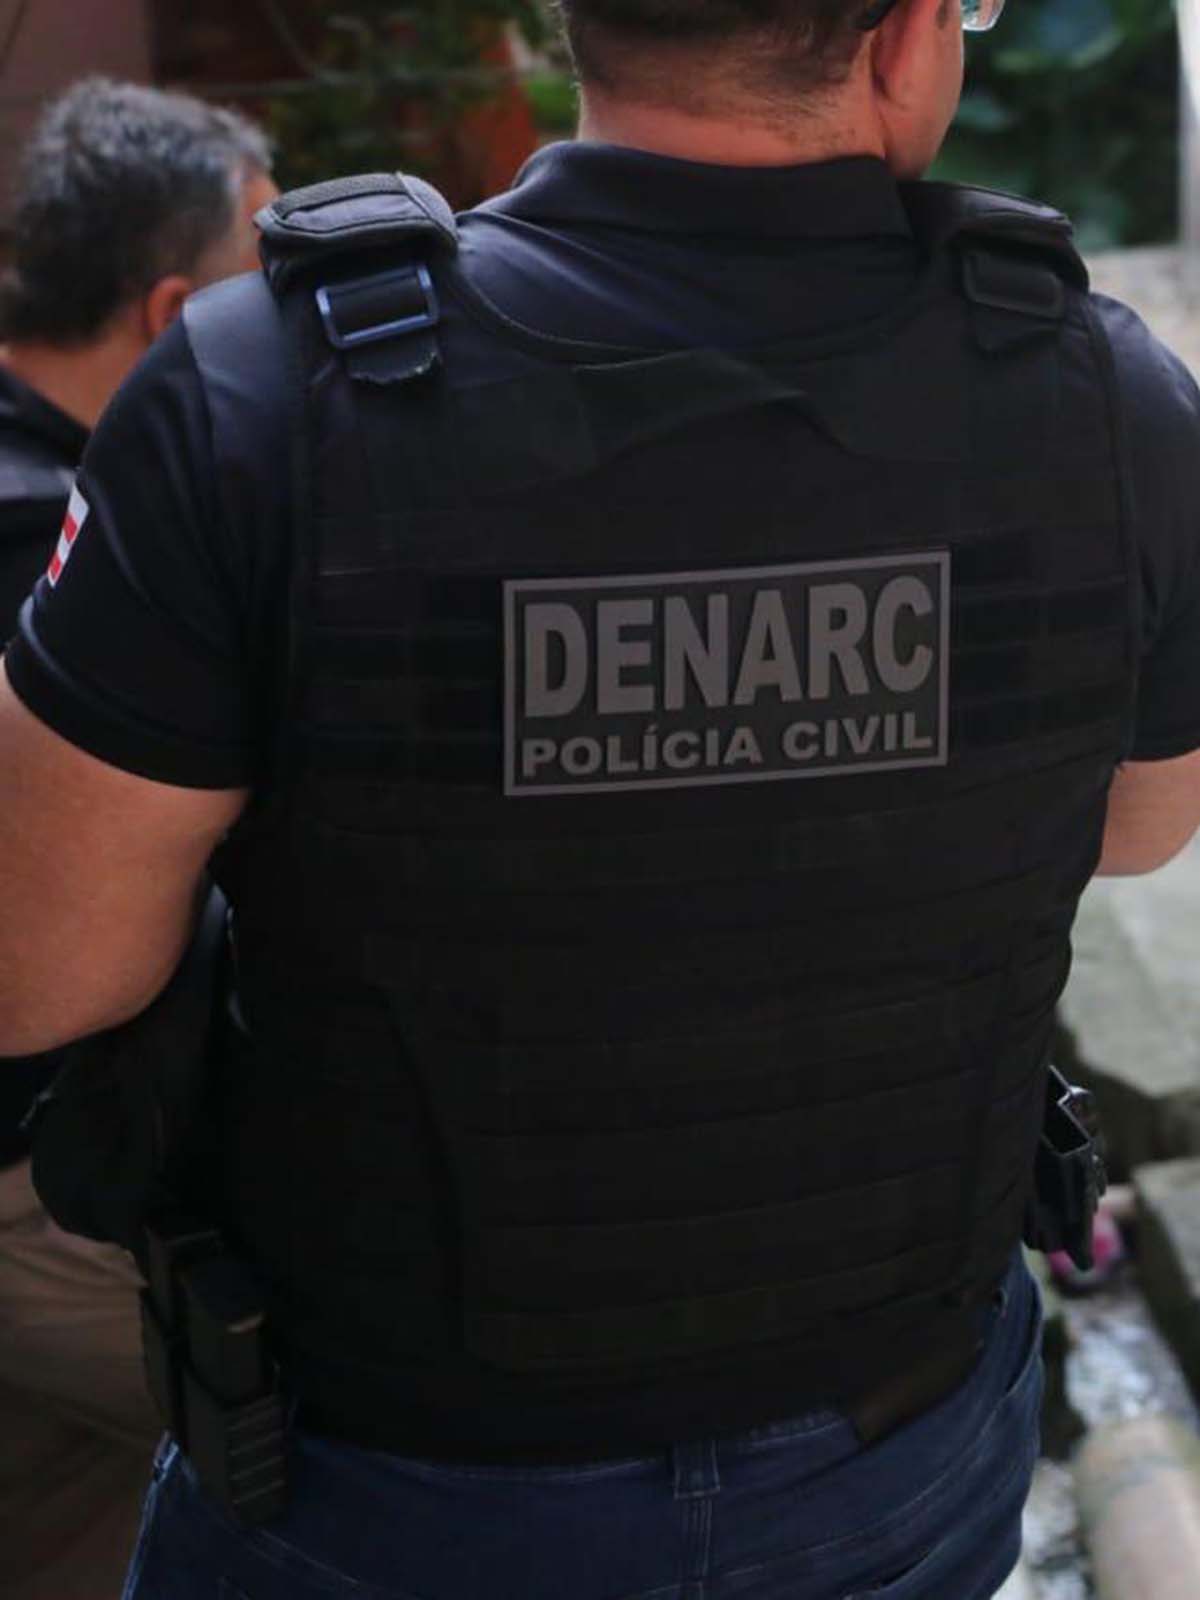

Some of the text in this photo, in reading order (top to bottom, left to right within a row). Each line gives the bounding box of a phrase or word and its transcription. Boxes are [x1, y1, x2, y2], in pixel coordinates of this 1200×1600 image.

[523, 576, 934, 718] DENARC
[521, 712, 933, 777] POLÍCIA CIVIL
